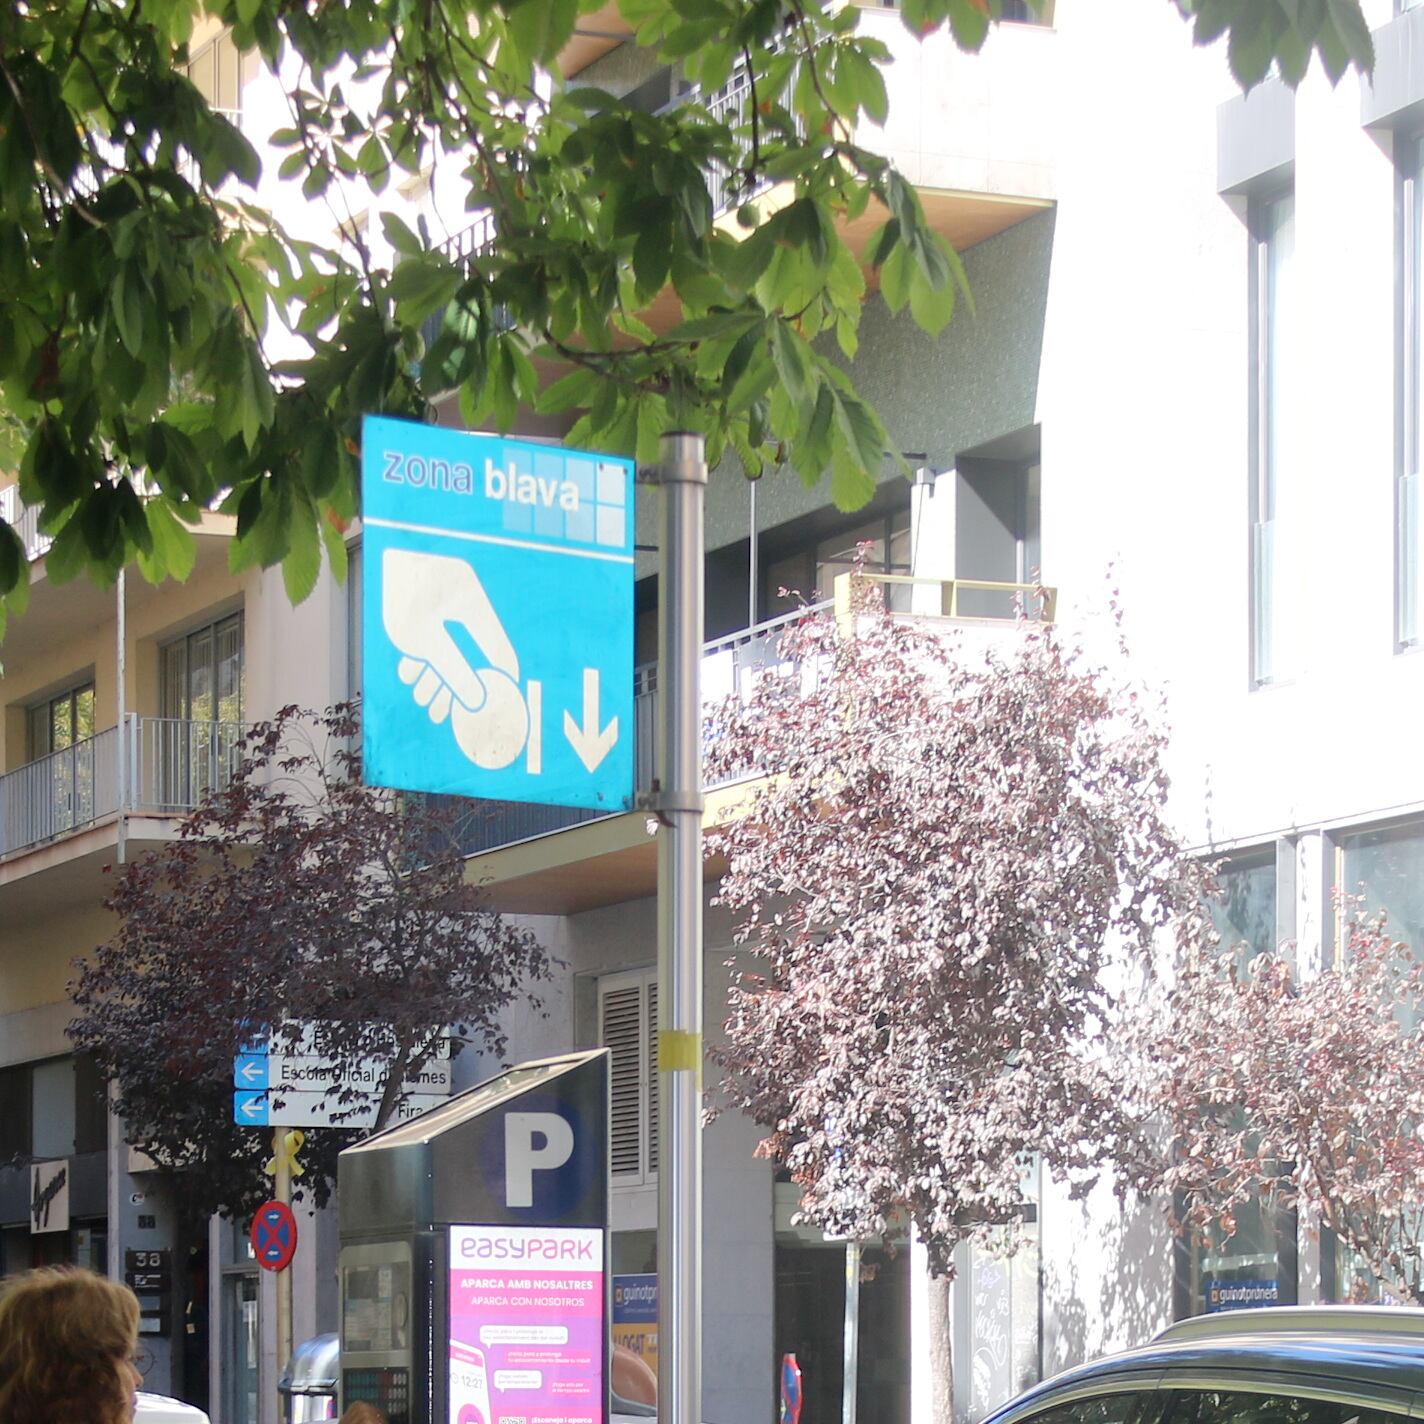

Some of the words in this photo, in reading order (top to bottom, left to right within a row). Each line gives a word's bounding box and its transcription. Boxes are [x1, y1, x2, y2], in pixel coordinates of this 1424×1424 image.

[383, 450, 473, 494] zona
[484, 458, 581, 512] blava
[281, 1065, 327, 1081] Escola
[504, 1111, 574, 1208] P
[136, 1252, 161, 1267] 38
[460, 1279, 505, 1289] APARCA
[507, 1279, 531, 1290] AMB
[533, 1279, 593, 1290] NOSALTRES
[471, 1296, 508, 1306] APARCA
[510, 1296, 533, 1306] CON
[534, 1297, 585, 1307] NOSOTROS
